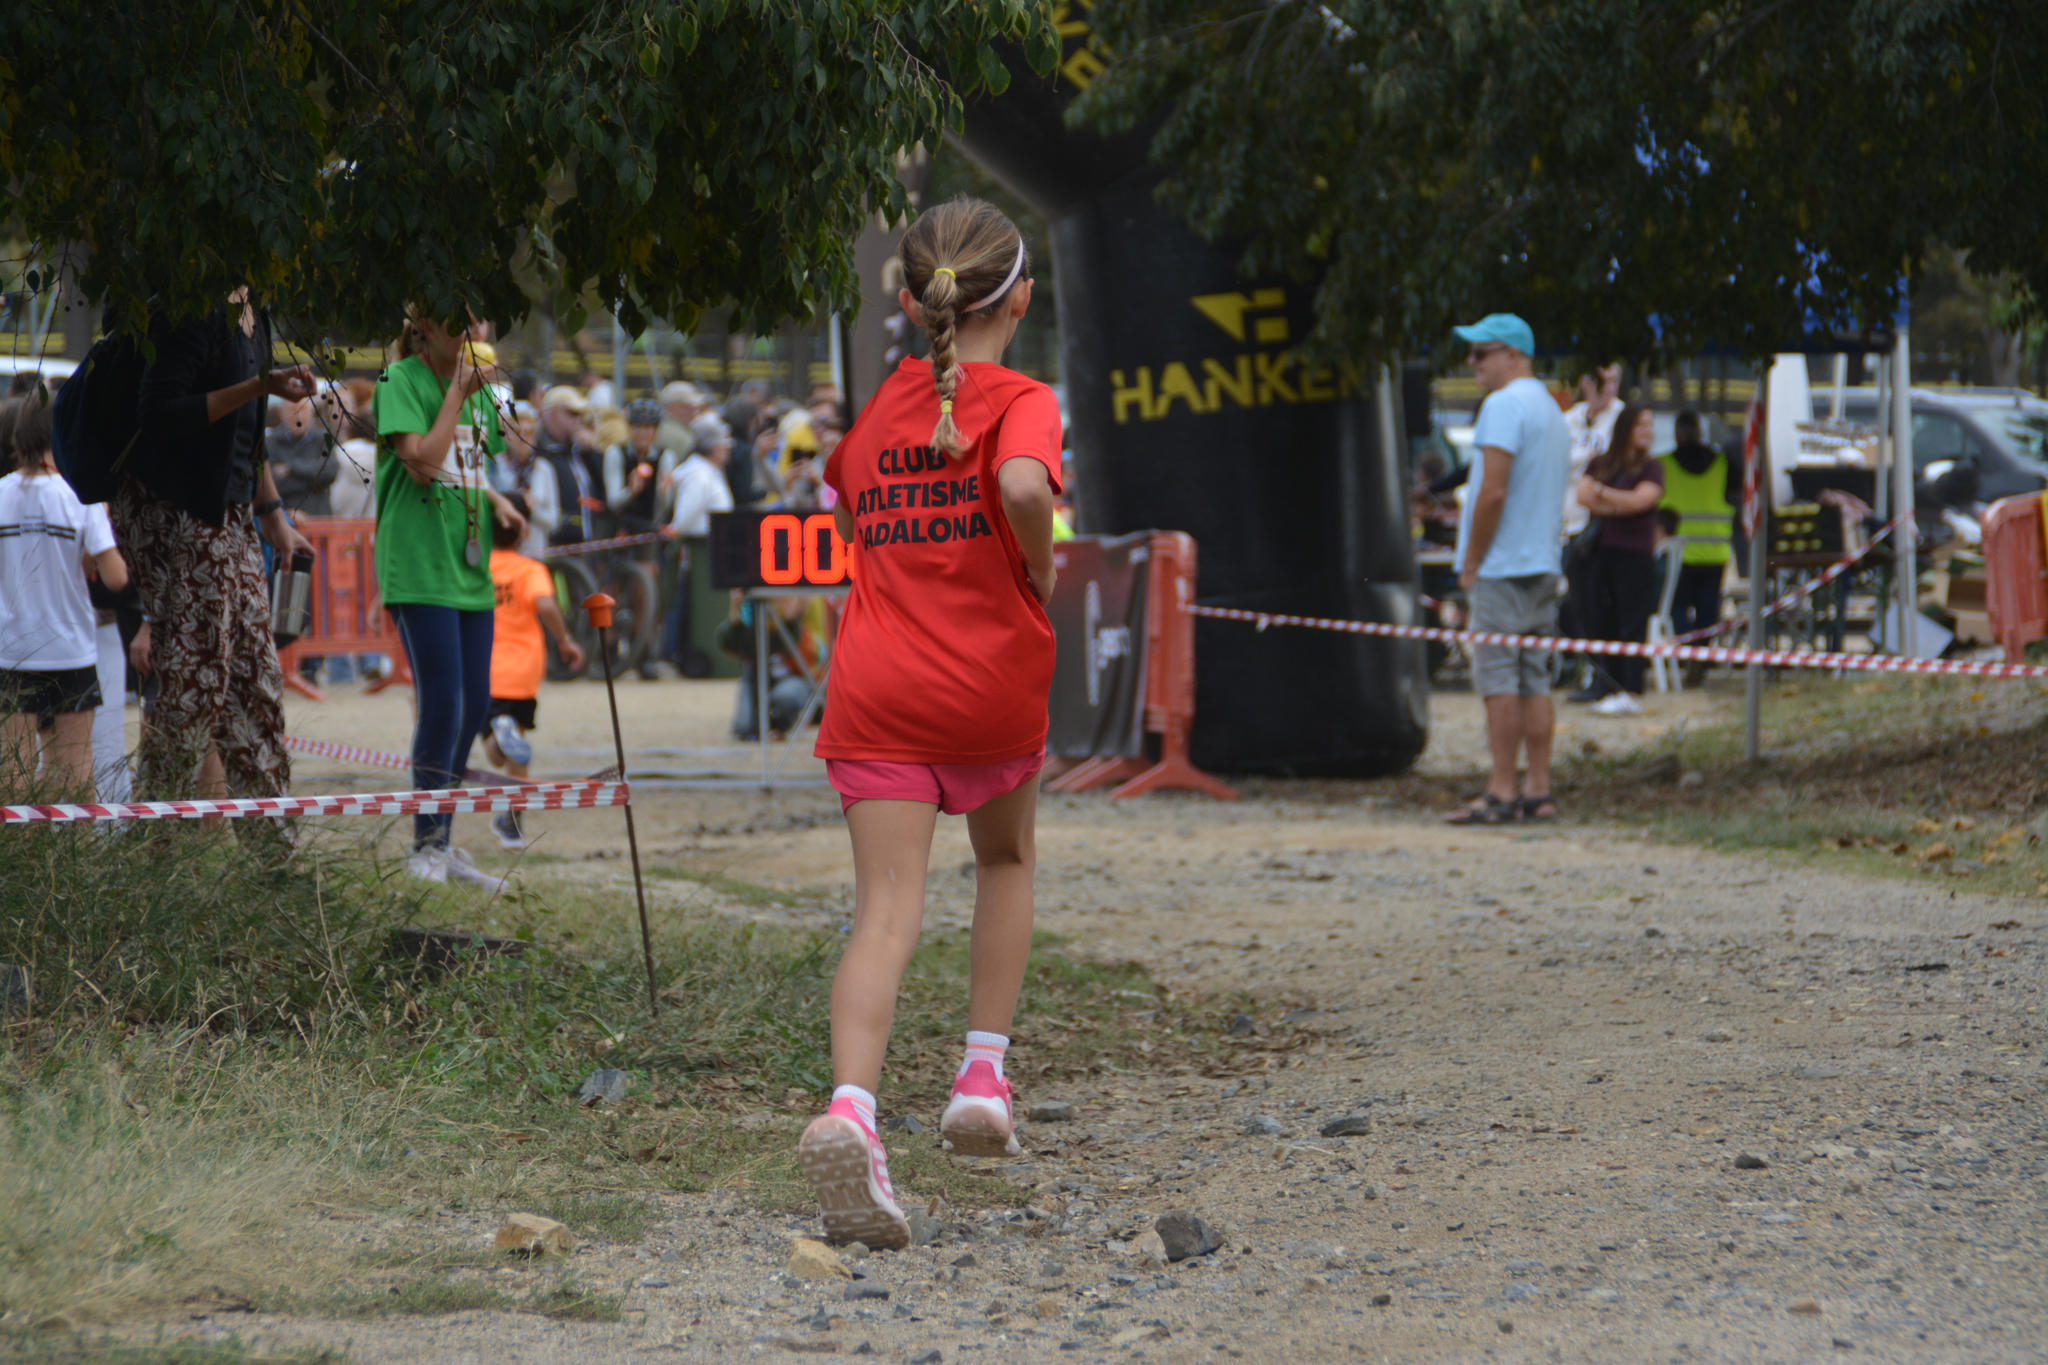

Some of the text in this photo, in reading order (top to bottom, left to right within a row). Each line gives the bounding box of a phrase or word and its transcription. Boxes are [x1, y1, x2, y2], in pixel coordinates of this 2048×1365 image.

[878, 446, 946, 475] CLUB
[856, 475, 980, 517] ATLETISME
[859, 512, 992, 550] ADALONA
